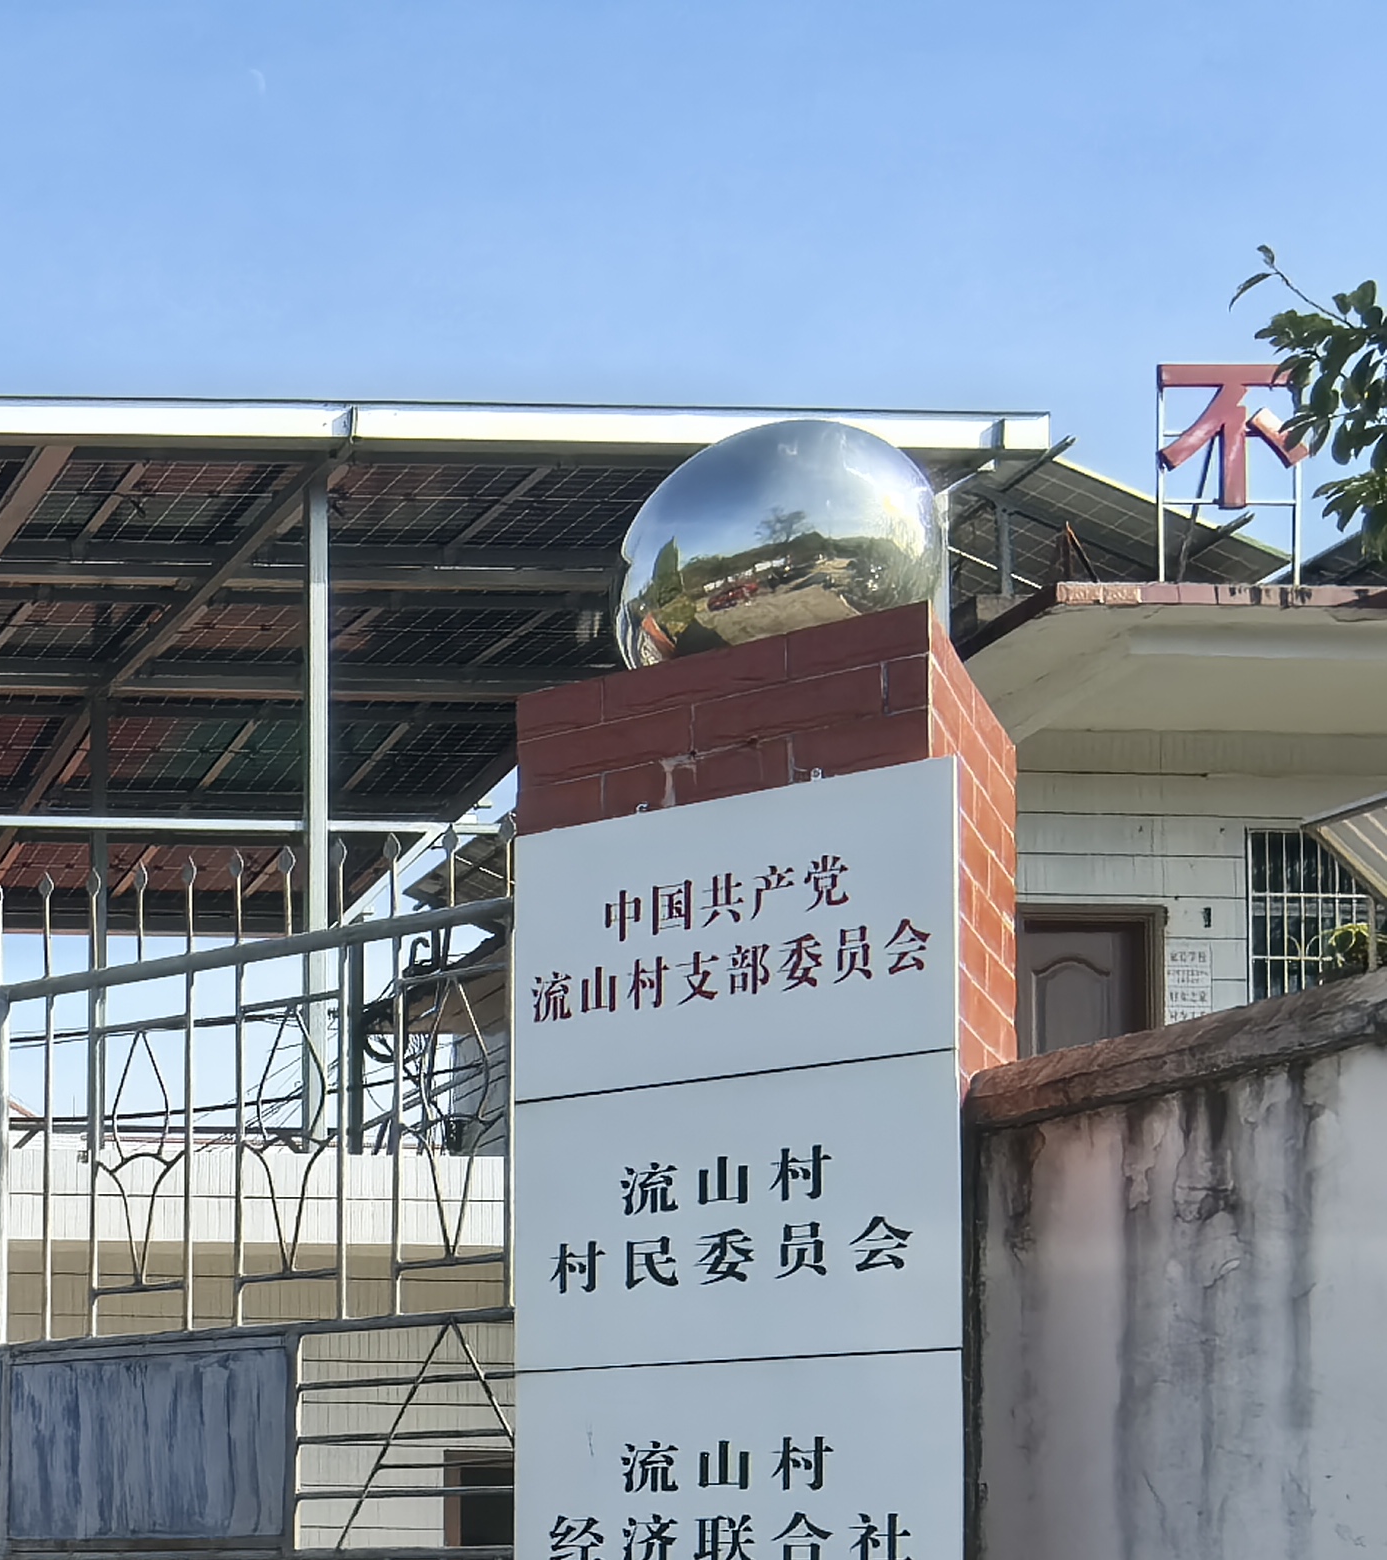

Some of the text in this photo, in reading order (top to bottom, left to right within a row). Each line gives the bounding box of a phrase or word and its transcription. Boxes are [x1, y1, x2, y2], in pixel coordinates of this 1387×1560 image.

[604, 854, 850, 943] 中国共产党
[531, 917, 932, 1023] 流山村支部委员会
[619, 1144, 832, 1216] 流山村
[549, 1215, 914, 1295] 村民委员会
[620, 1436, 834, 1493] 流山村
